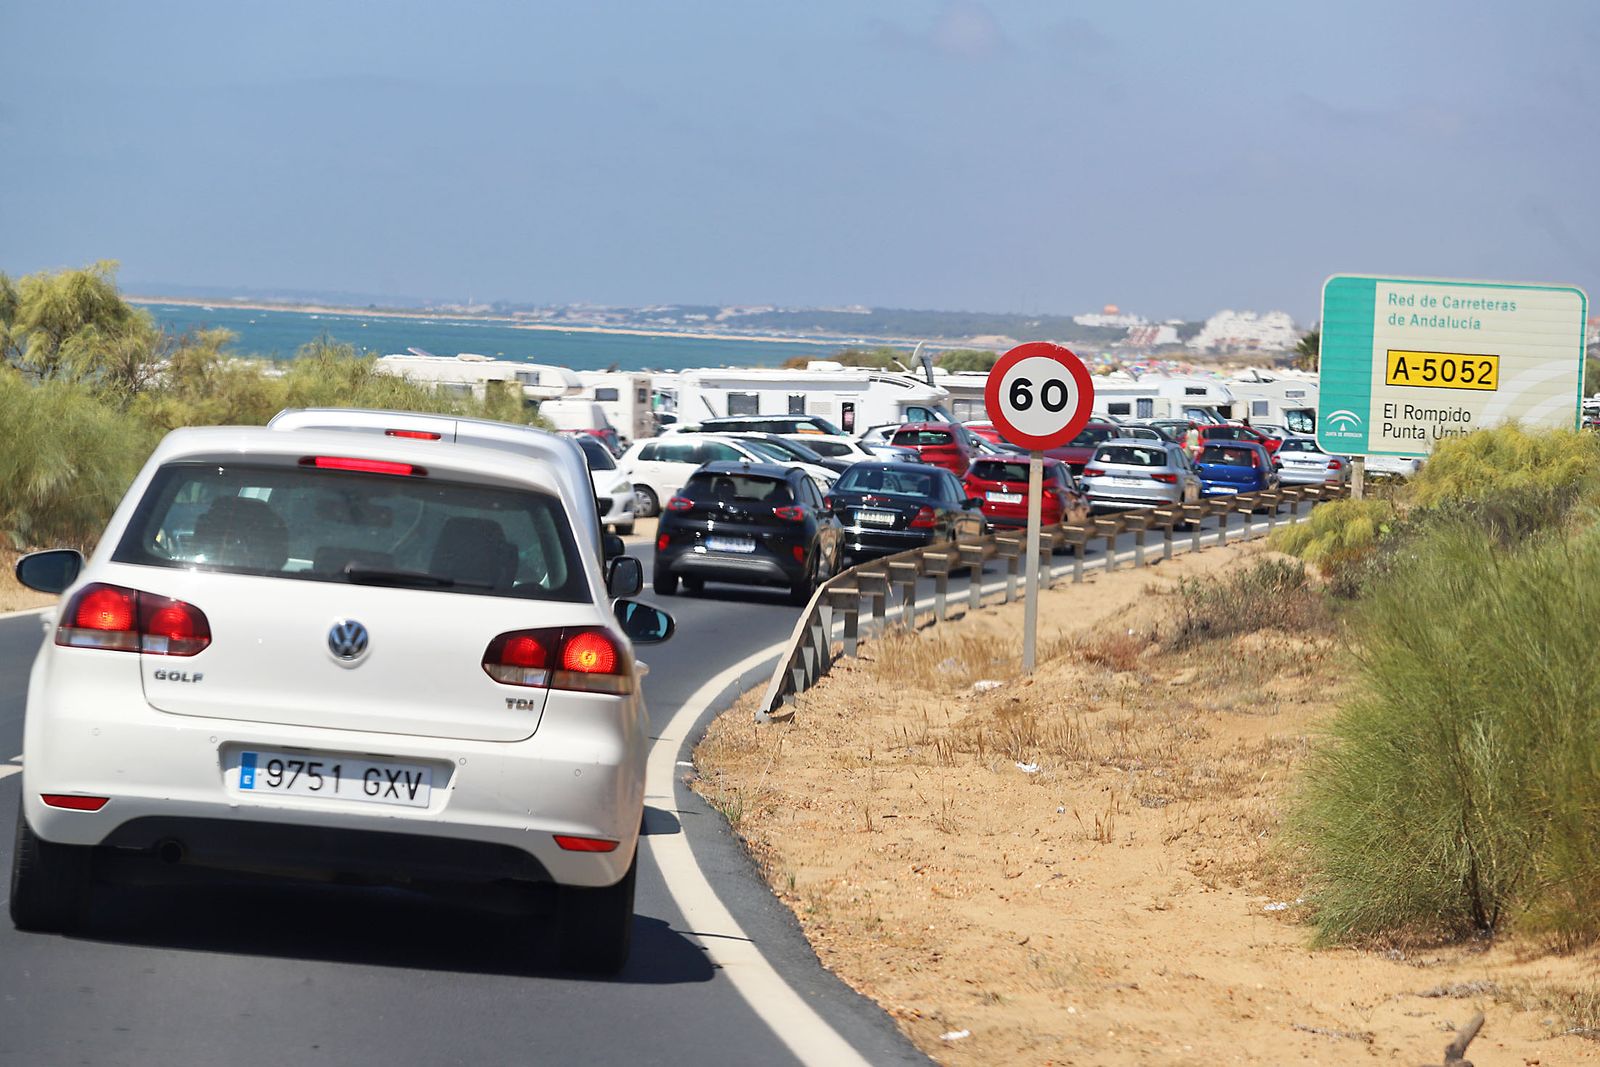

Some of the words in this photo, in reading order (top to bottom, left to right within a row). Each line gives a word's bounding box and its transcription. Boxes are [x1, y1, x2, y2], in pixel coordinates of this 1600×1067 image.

[1388, 293, 1414, 307] Red
[1420, 295, 1437, 308] de
[1442, 296, 1517, 312] Carreteras
[1388, 313, 1405, 326] de
[1410, 314, 1481, 330] Andalucía
[1392, 357, 1493, 385] A-5052
[1009, 377, 1069, 413] 60
[1383, 403, 1397, 419] El
[1404, 404, 1471, 424] Rompido
[1382, 422, 1425, 439] Punta
[154, 668, 204, 683] GOLF
[505, 698, 534, 711] TDI
[243, 775, 252, 784] E
[266, 759, 342, 794] 9751
[363, 768, 422, 801] GXV
